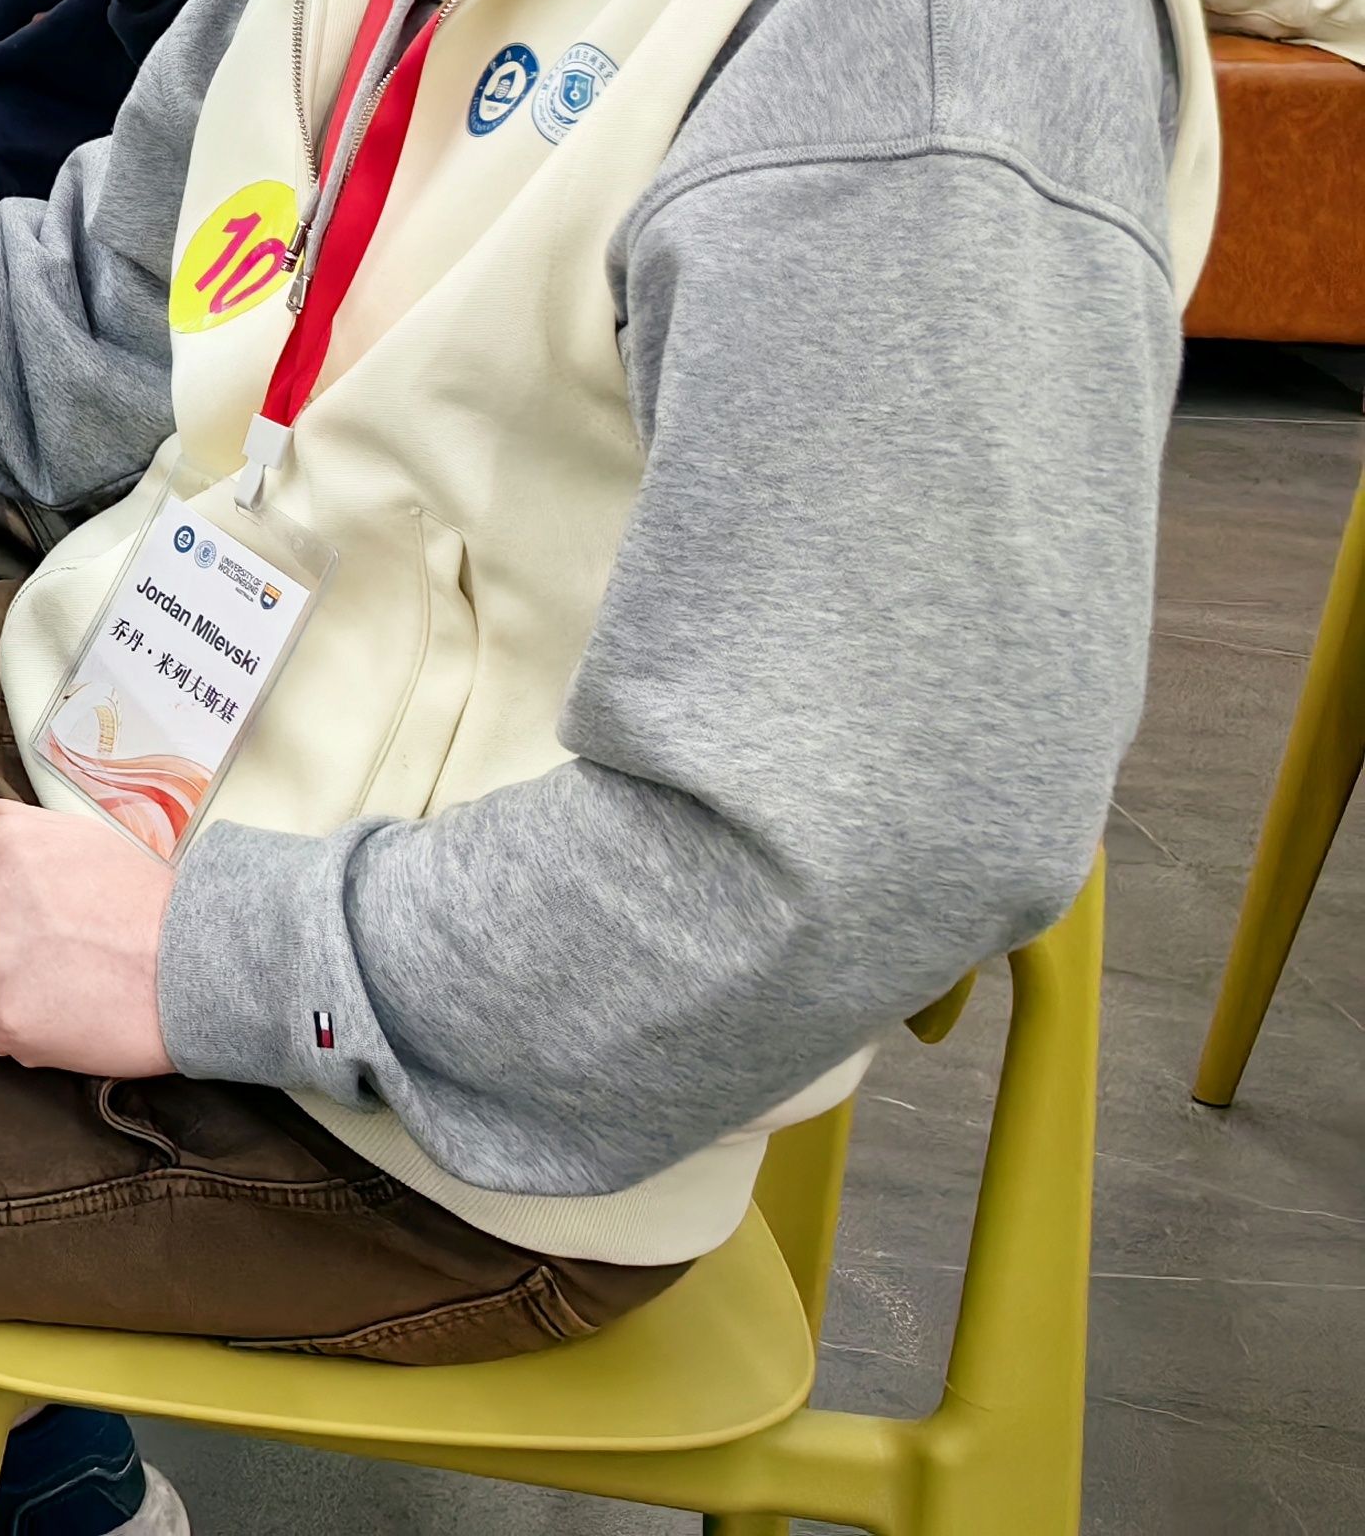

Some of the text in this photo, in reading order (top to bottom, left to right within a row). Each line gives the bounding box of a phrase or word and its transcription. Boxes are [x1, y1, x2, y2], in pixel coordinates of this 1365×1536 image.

[194, 212, 288, 314] 10
[217, 562, 260, 596] WOLLONGONG
[221, 555, 263, 587] UNIVERSITY OF
[109, 618, 239, 724] 乔丹·米列夫斯基
[136, 576, 261, 675] Jordan Milevski
